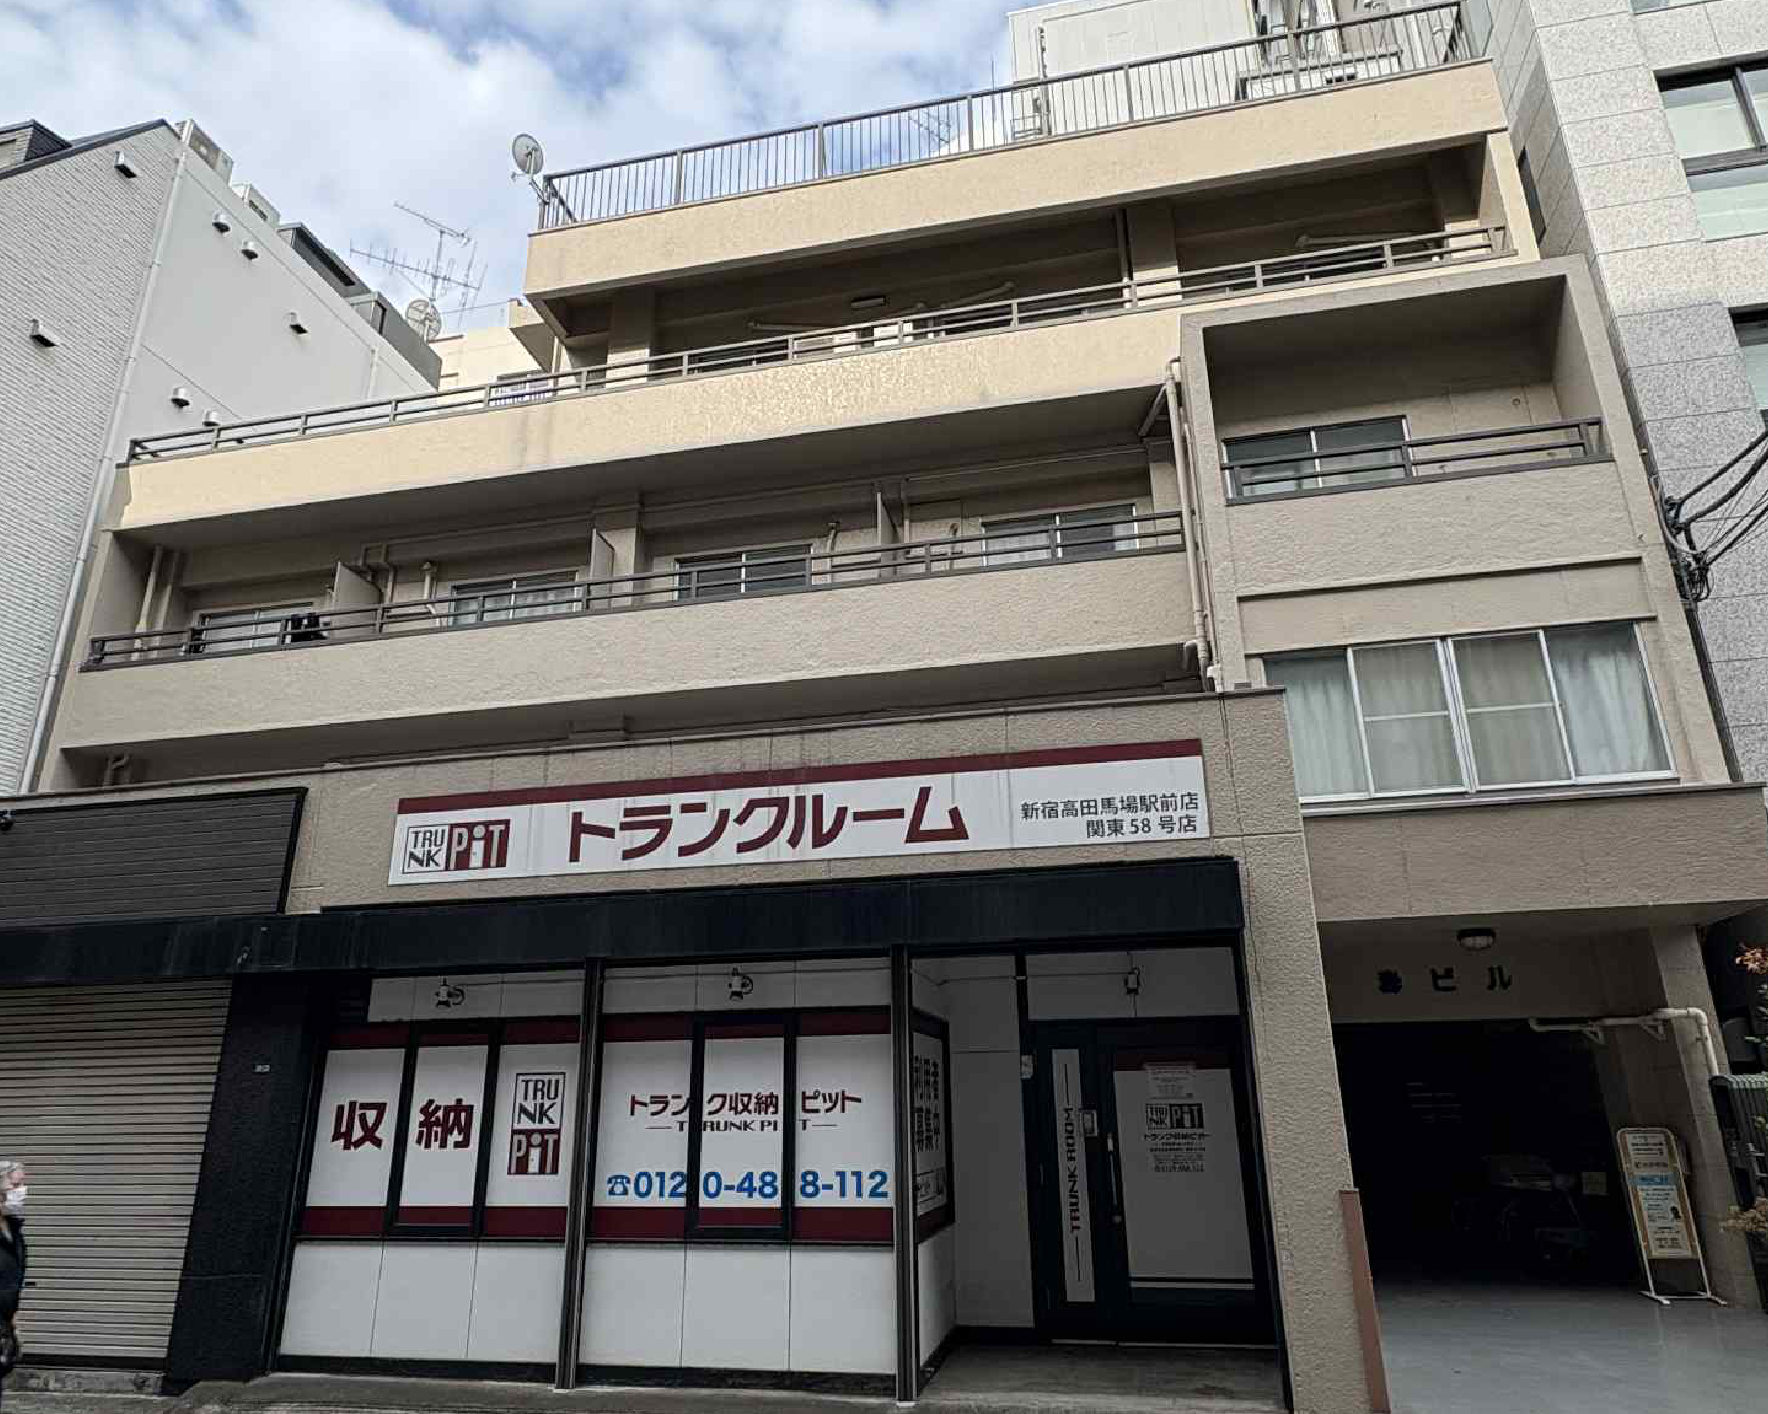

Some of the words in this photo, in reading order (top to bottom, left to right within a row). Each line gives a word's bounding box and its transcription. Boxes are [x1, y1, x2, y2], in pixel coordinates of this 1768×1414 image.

[570, 786, 969, 863] トランクルーム
[1020, 791, 1200, 821] 新宿高田馬場駅前店
[1067, 1166, 1081, 1234] TRUNK
